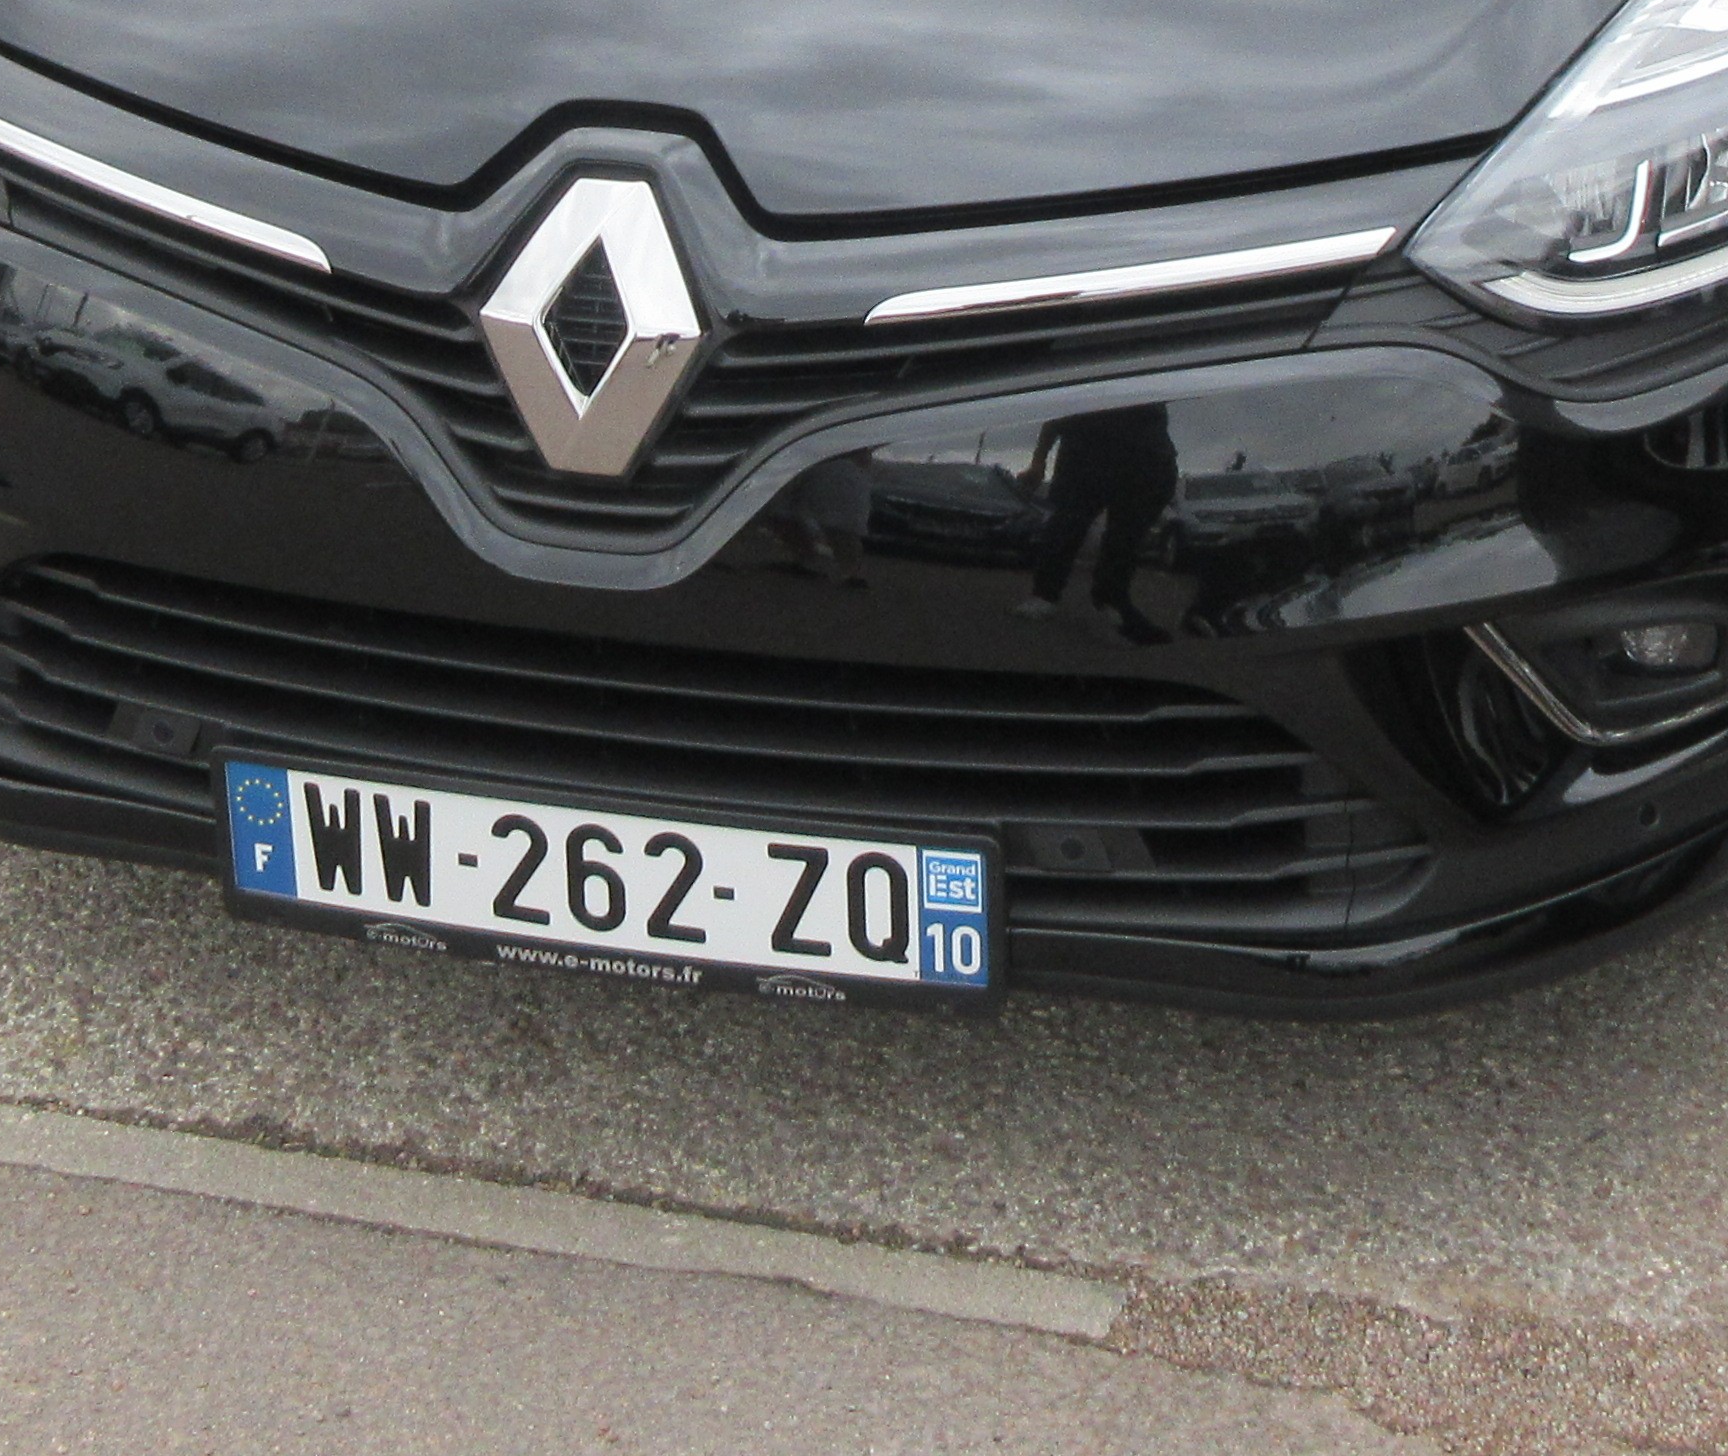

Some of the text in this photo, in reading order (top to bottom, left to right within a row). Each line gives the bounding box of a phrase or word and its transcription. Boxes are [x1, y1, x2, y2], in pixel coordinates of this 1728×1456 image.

[254, 843, 273, 872] F
[303, 782, 909, 963] WW-262-ZQ
[929, 861, 976, 876] Grand
[928, 874, 977, 900] Est
[496, 944, 704, 984] www.e-motors.fr
[926, 923, 982, 975] 10
